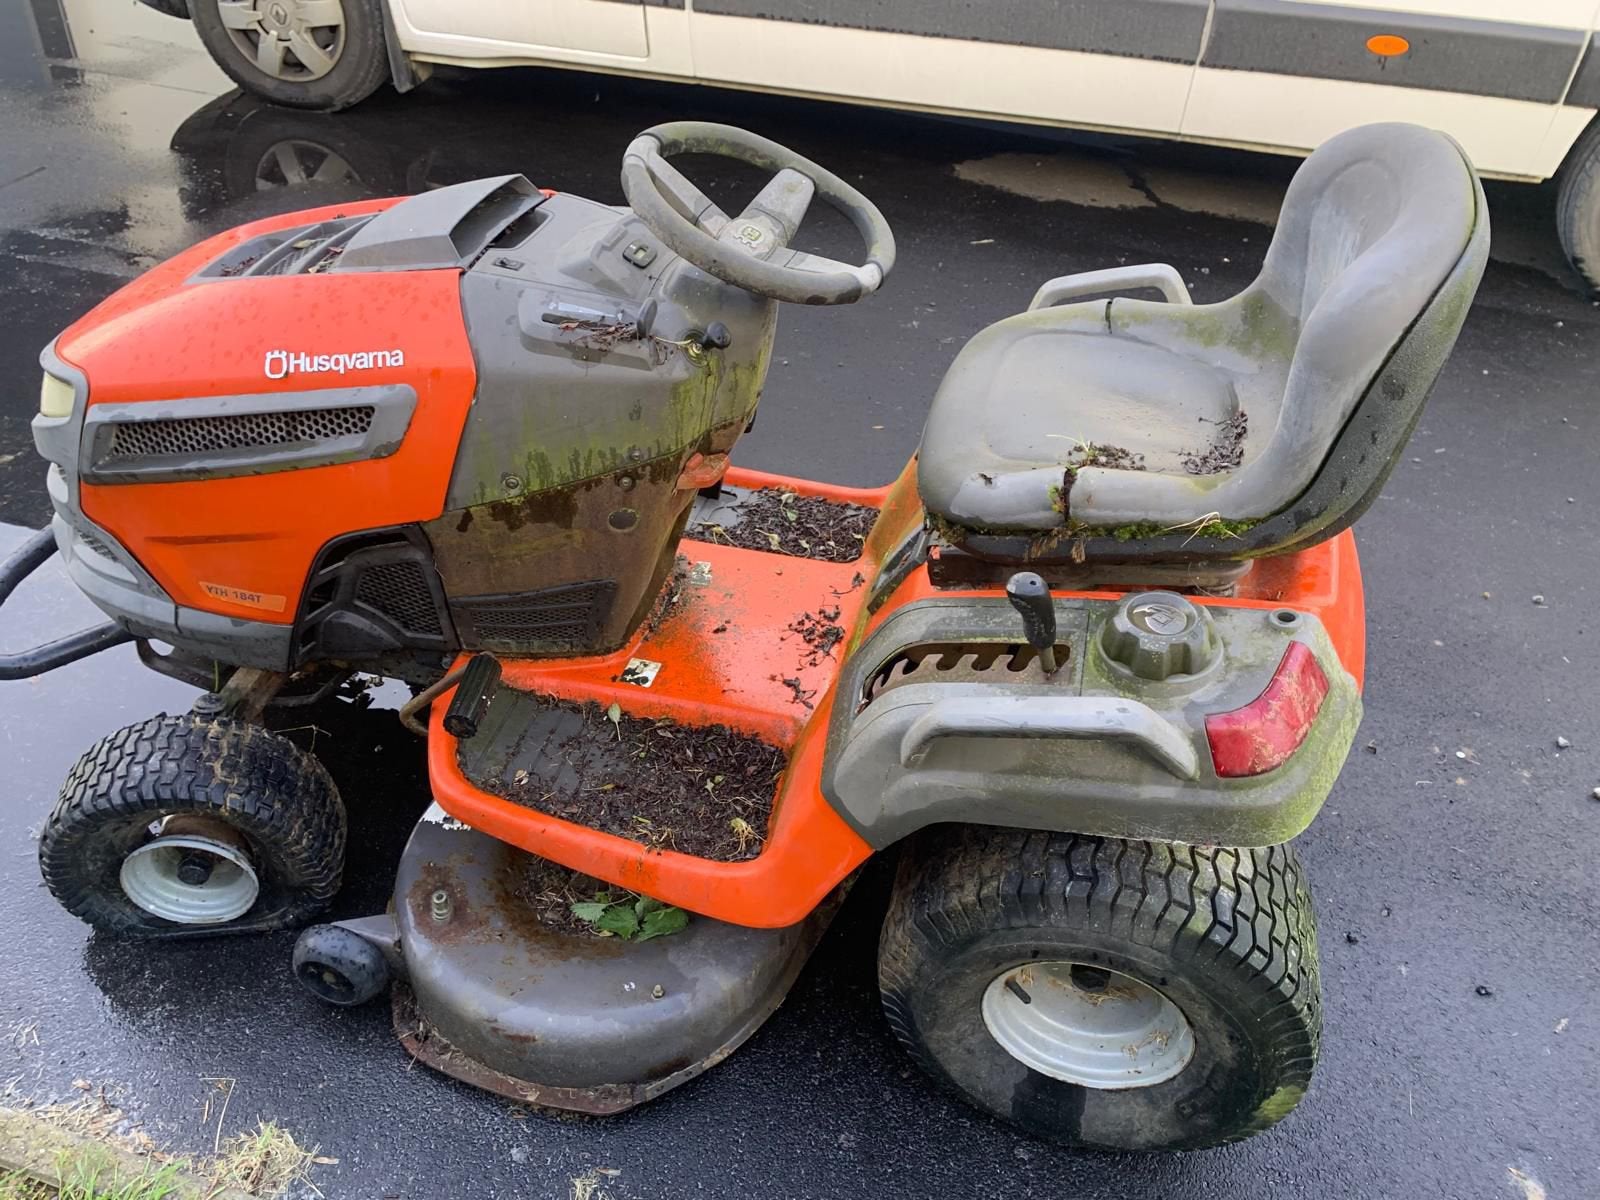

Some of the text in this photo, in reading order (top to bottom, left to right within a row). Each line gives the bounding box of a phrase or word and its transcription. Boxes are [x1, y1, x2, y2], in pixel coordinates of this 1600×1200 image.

[288, 349, 404, 374] Husqvarna
[206, 585, 262, 603] YTH 184T
